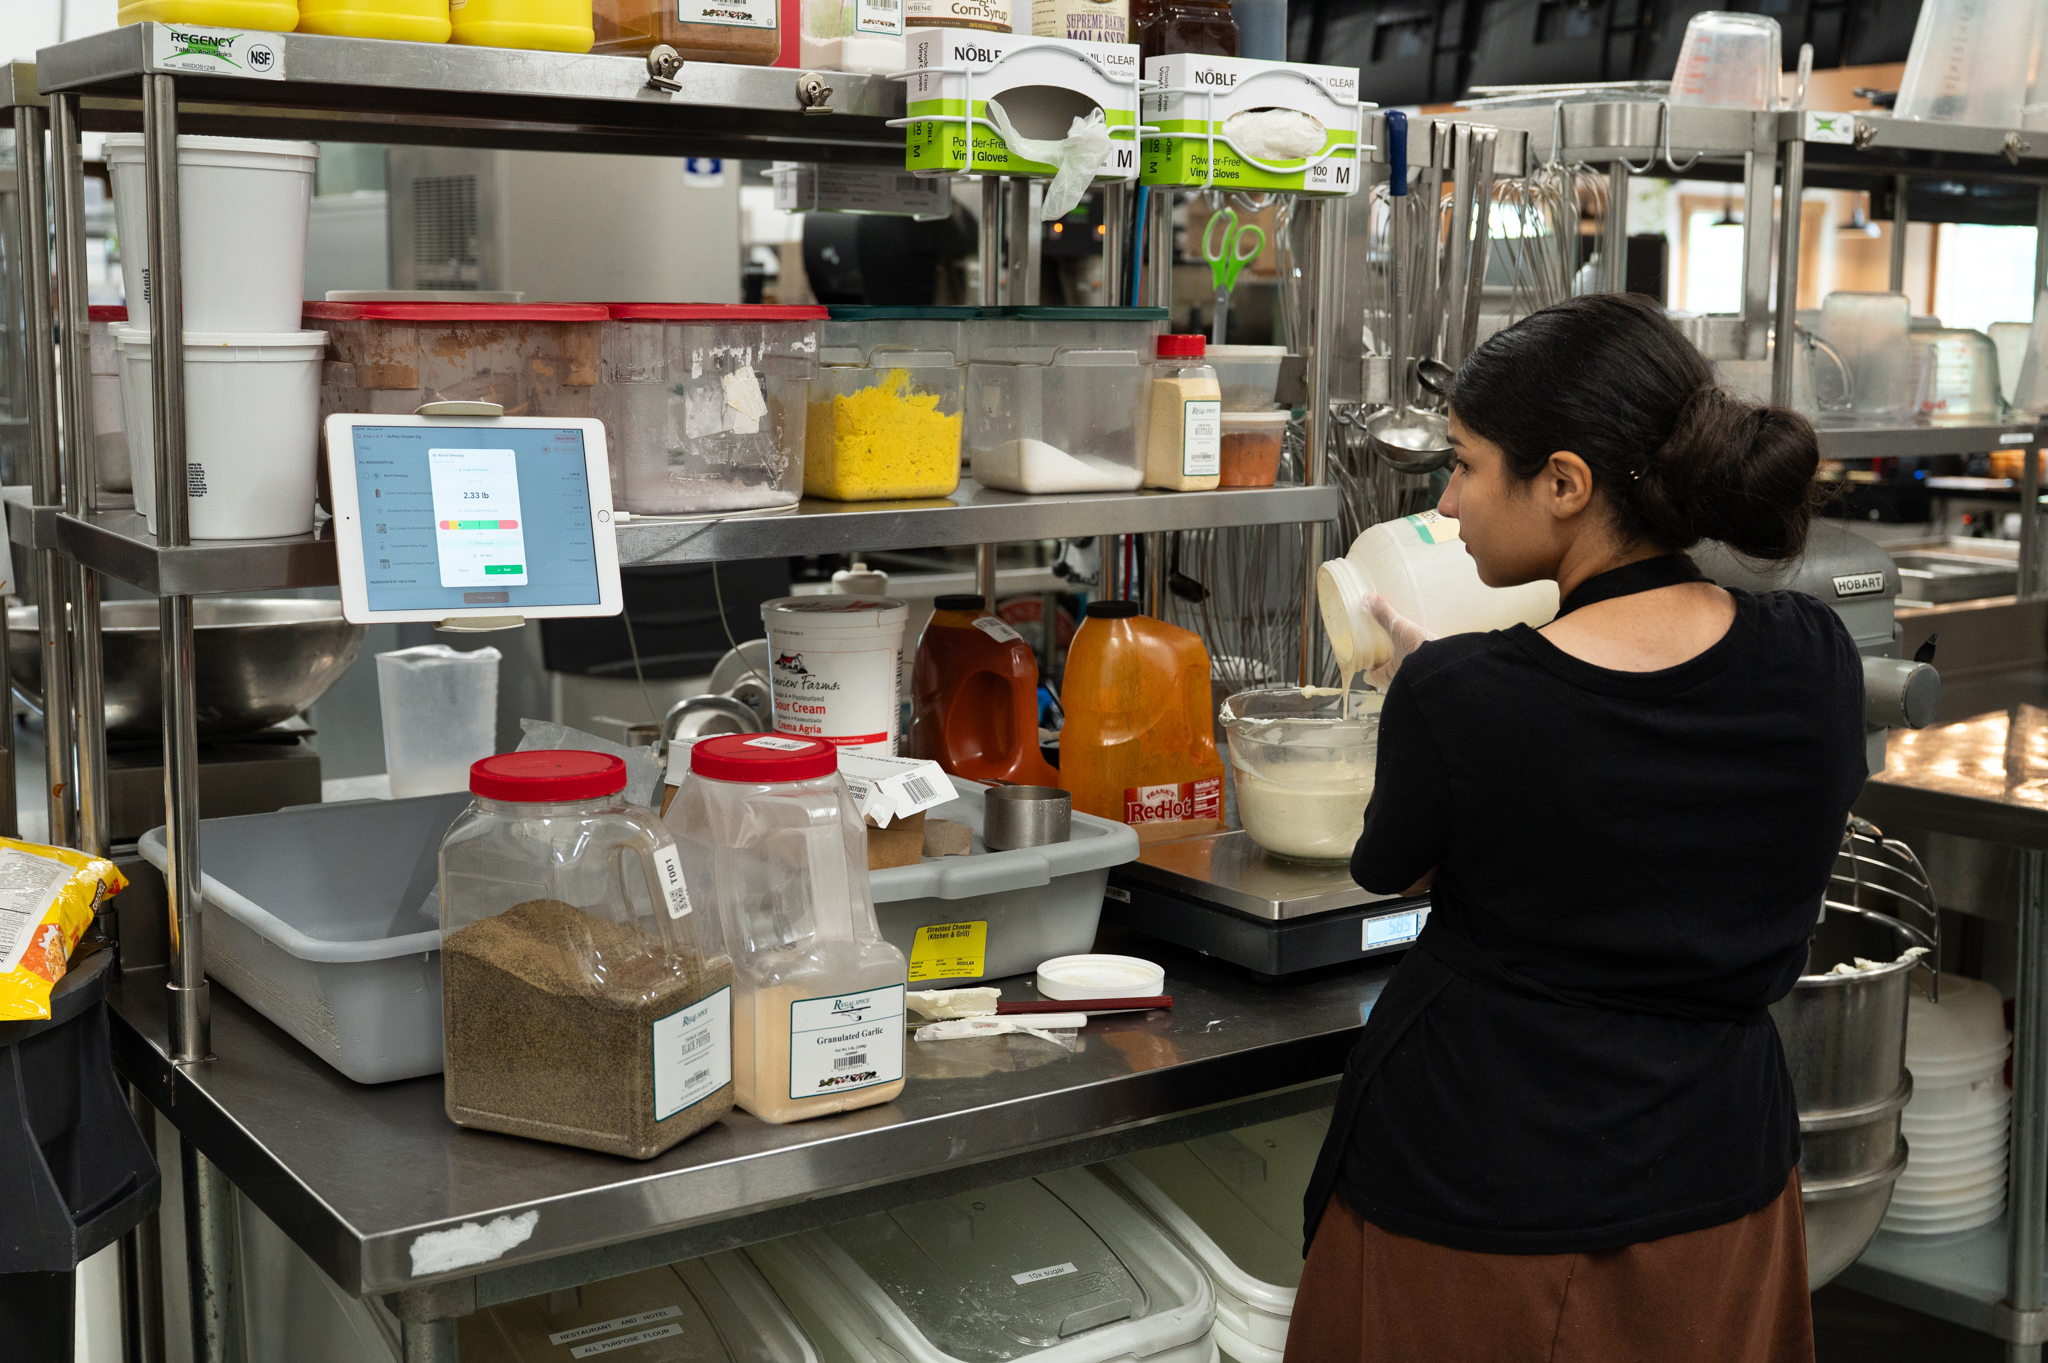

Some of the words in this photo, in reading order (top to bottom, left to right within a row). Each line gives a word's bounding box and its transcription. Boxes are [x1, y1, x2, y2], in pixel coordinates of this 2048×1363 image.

[952, 3, 981, 16] Corn
[983, 6, 1008, 23] Syrup
[1066, 14, 1103, 29] SUPREME
[1104, 15, 1125, 32] BAKING
[170, 32, 234, 48] REGENCY
[174, 45, 196, 54] Tables
[1106, 54, 1135, 66] CLEAR
[1330, 78, 1354, 88] CLEAR
[914, 145, 920, 158] M
[977, 151, 1008, 162] Gloves
[1117, 150, 1132, 168] M
[1150, 162, 1157, 173] M
[1213, 169, 1240, 179] Gloves
[1312, 166, 1327, 176] 100
[1336, 167, 1350, 184] M
[1838, 578, 1881, 591] HOBART
[792, 694, 824, 702] Pasteurized
[774, 698, 790, 711] Sour
[792, 702, 826, 715] Cream
[778, 720, 797, 732] Crema
[799, 723, 822, 735] Agria
[1146, 789, 1175, 800] FRANK'S
[1127, 797, 1191, 824] RedHot
[665, 859, 677, 885] T001
[926, 925, 951, 933] Shredded
[928, 932, 949, 941] (Kitchen
[833, 999, 854, 1010] REGAL
[685, 1033, 696, 1042] TABLE
[817, 1032, 859, 1045] Granulated
[862, 1027, 883, 1038] Garlic
[682, 1041, 695, 1056] BLACK
[696, 1032, 711, 1049] PEPPER
[1044, 1267, 1065, 1277] sugar
[560, 1324, 612, 1340] RESTAURANT
[643, 1311, 669, 1320] HOTEL
[602, 1336, 640, 1349] PURPOSE
[644, 1329, 670, 1339] FLOUR
